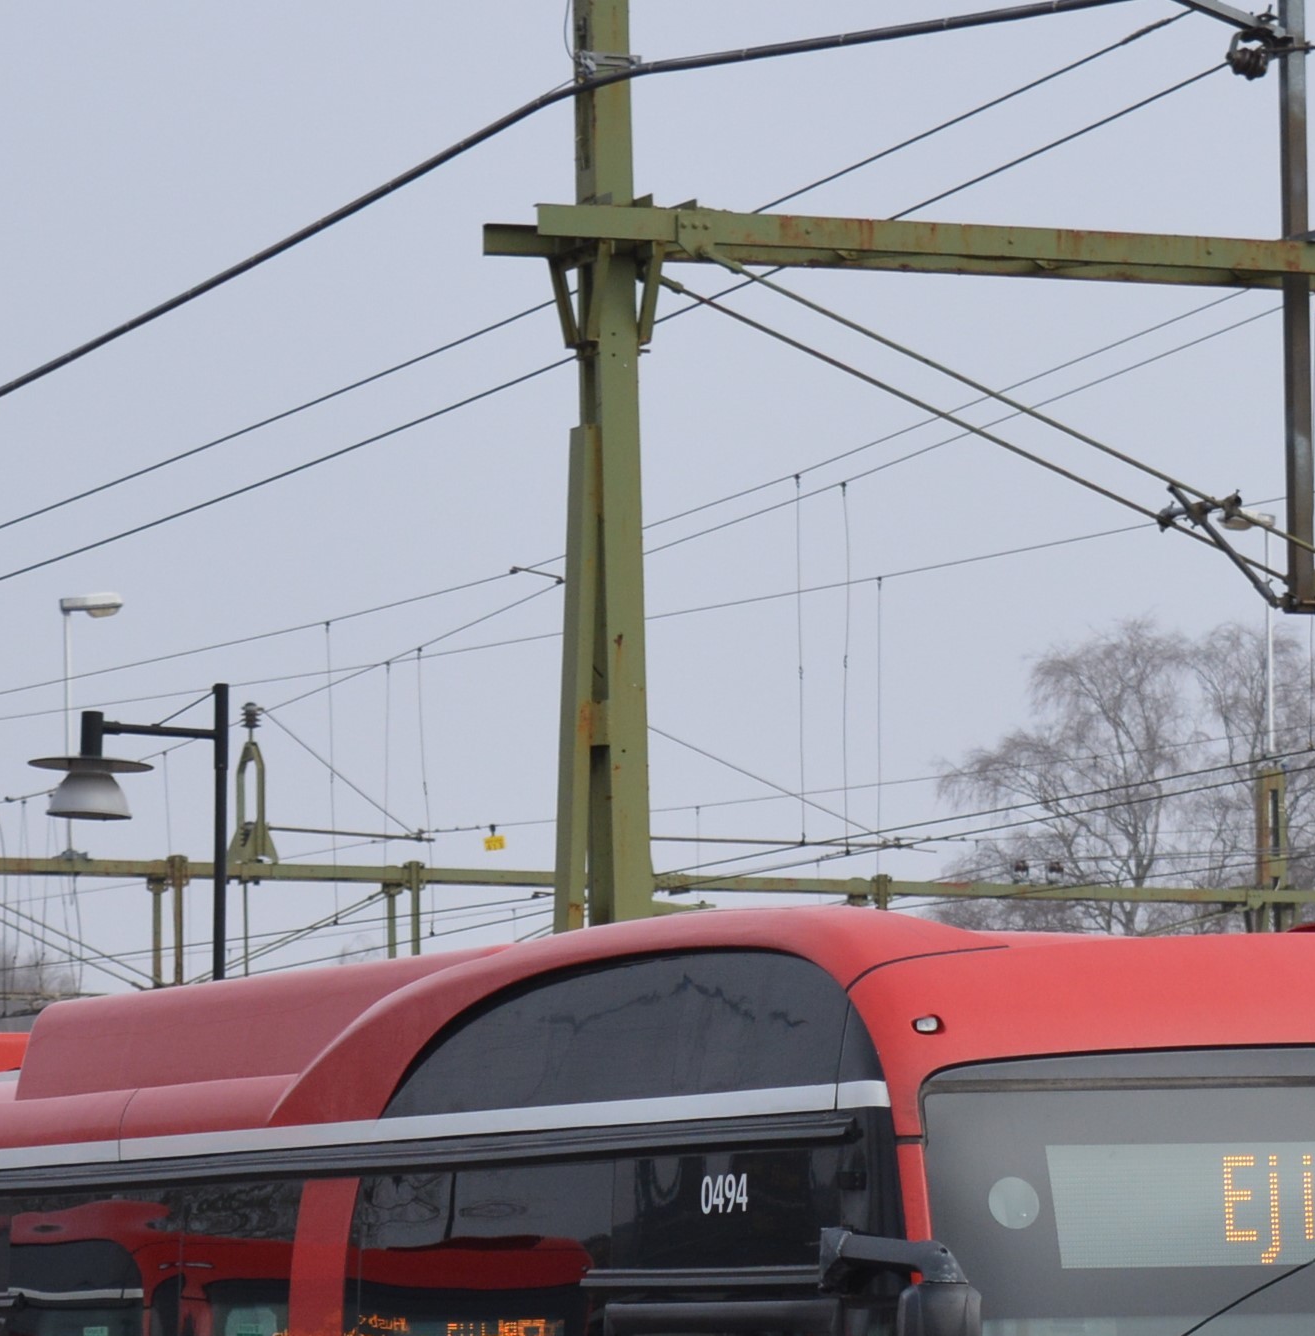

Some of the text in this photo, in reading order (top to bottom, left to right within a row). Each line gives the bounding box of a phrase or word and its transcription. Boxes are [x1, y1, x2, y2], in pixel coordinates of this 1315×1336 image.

[701, 1173, 748, 1214] 0494
[1222, 1155, 1280, 1263] Ej
[1302, 1154, 1314, 1239] i
